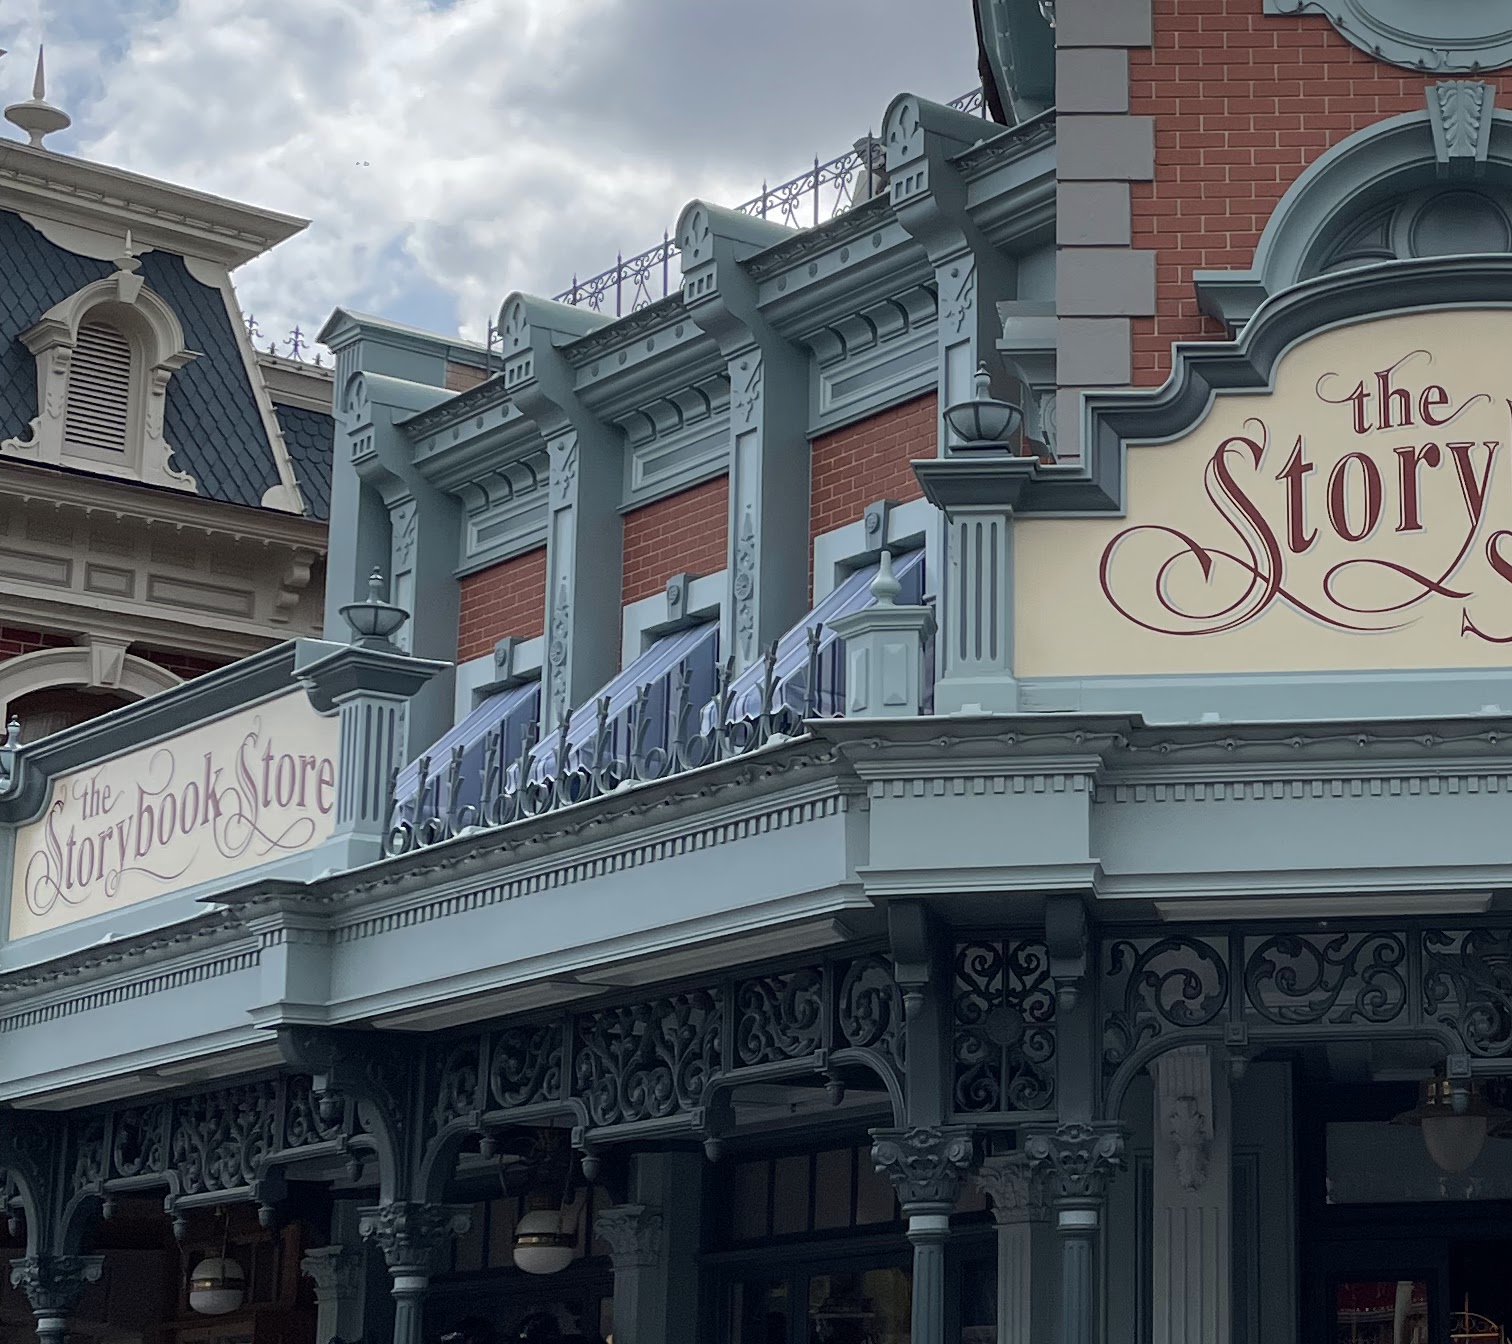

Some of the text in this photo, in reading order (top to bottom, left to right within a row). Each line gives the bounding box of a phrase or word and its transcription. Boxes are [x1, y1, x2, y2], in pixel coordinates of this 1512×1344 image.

[1316, 349, 1491, 433] the
[25, 715, 336, 916] Storybook Store
[72, 765, 125, 821] the
